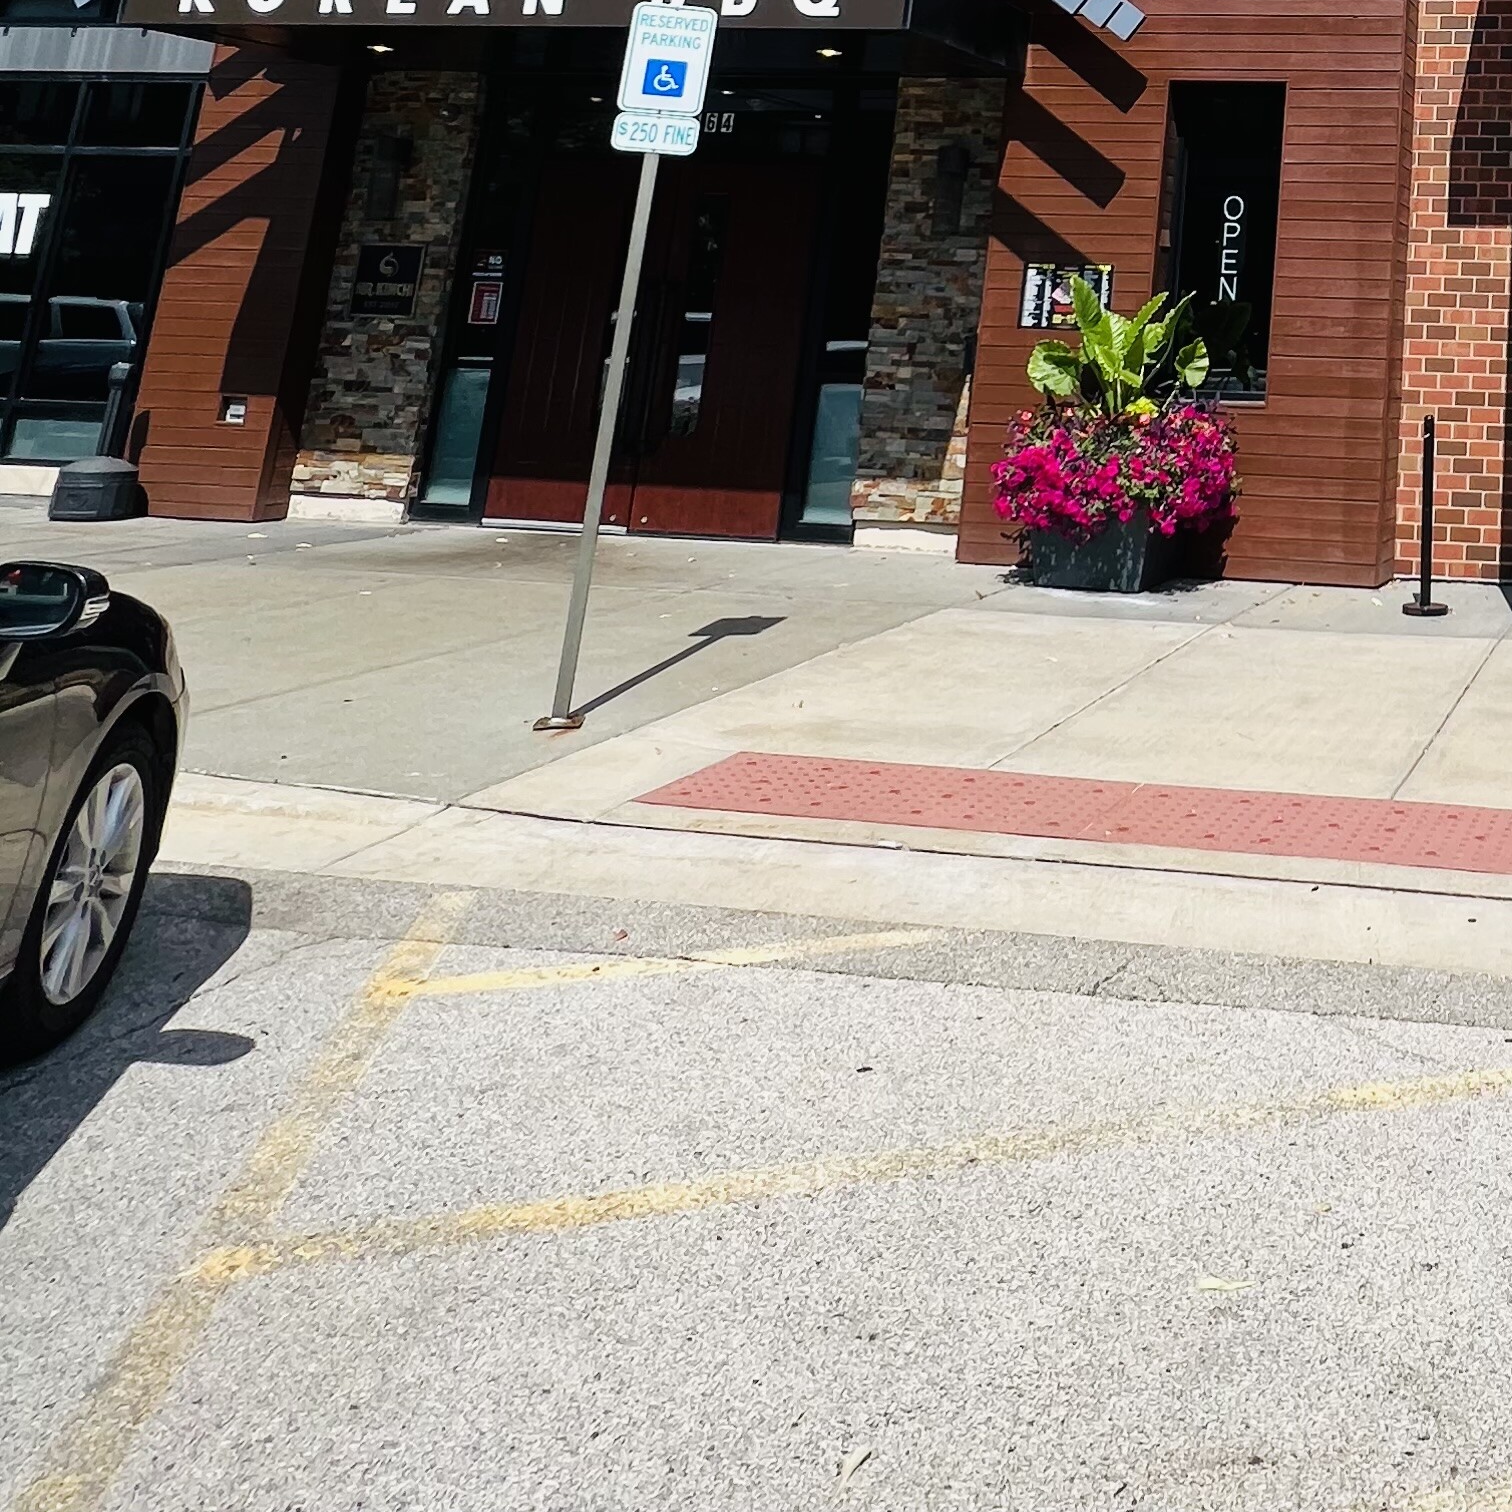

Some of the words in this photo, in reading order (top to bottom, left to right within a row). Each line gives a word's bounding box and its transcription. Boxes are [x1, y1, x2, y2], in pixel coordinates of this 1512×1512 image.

[640, 13, 709, 32] RESERVED
[641, 32, 701, 50] PARKING
[664, 125, 695, 146] FINE
[1218, 195, 1244, 301] OPEN
